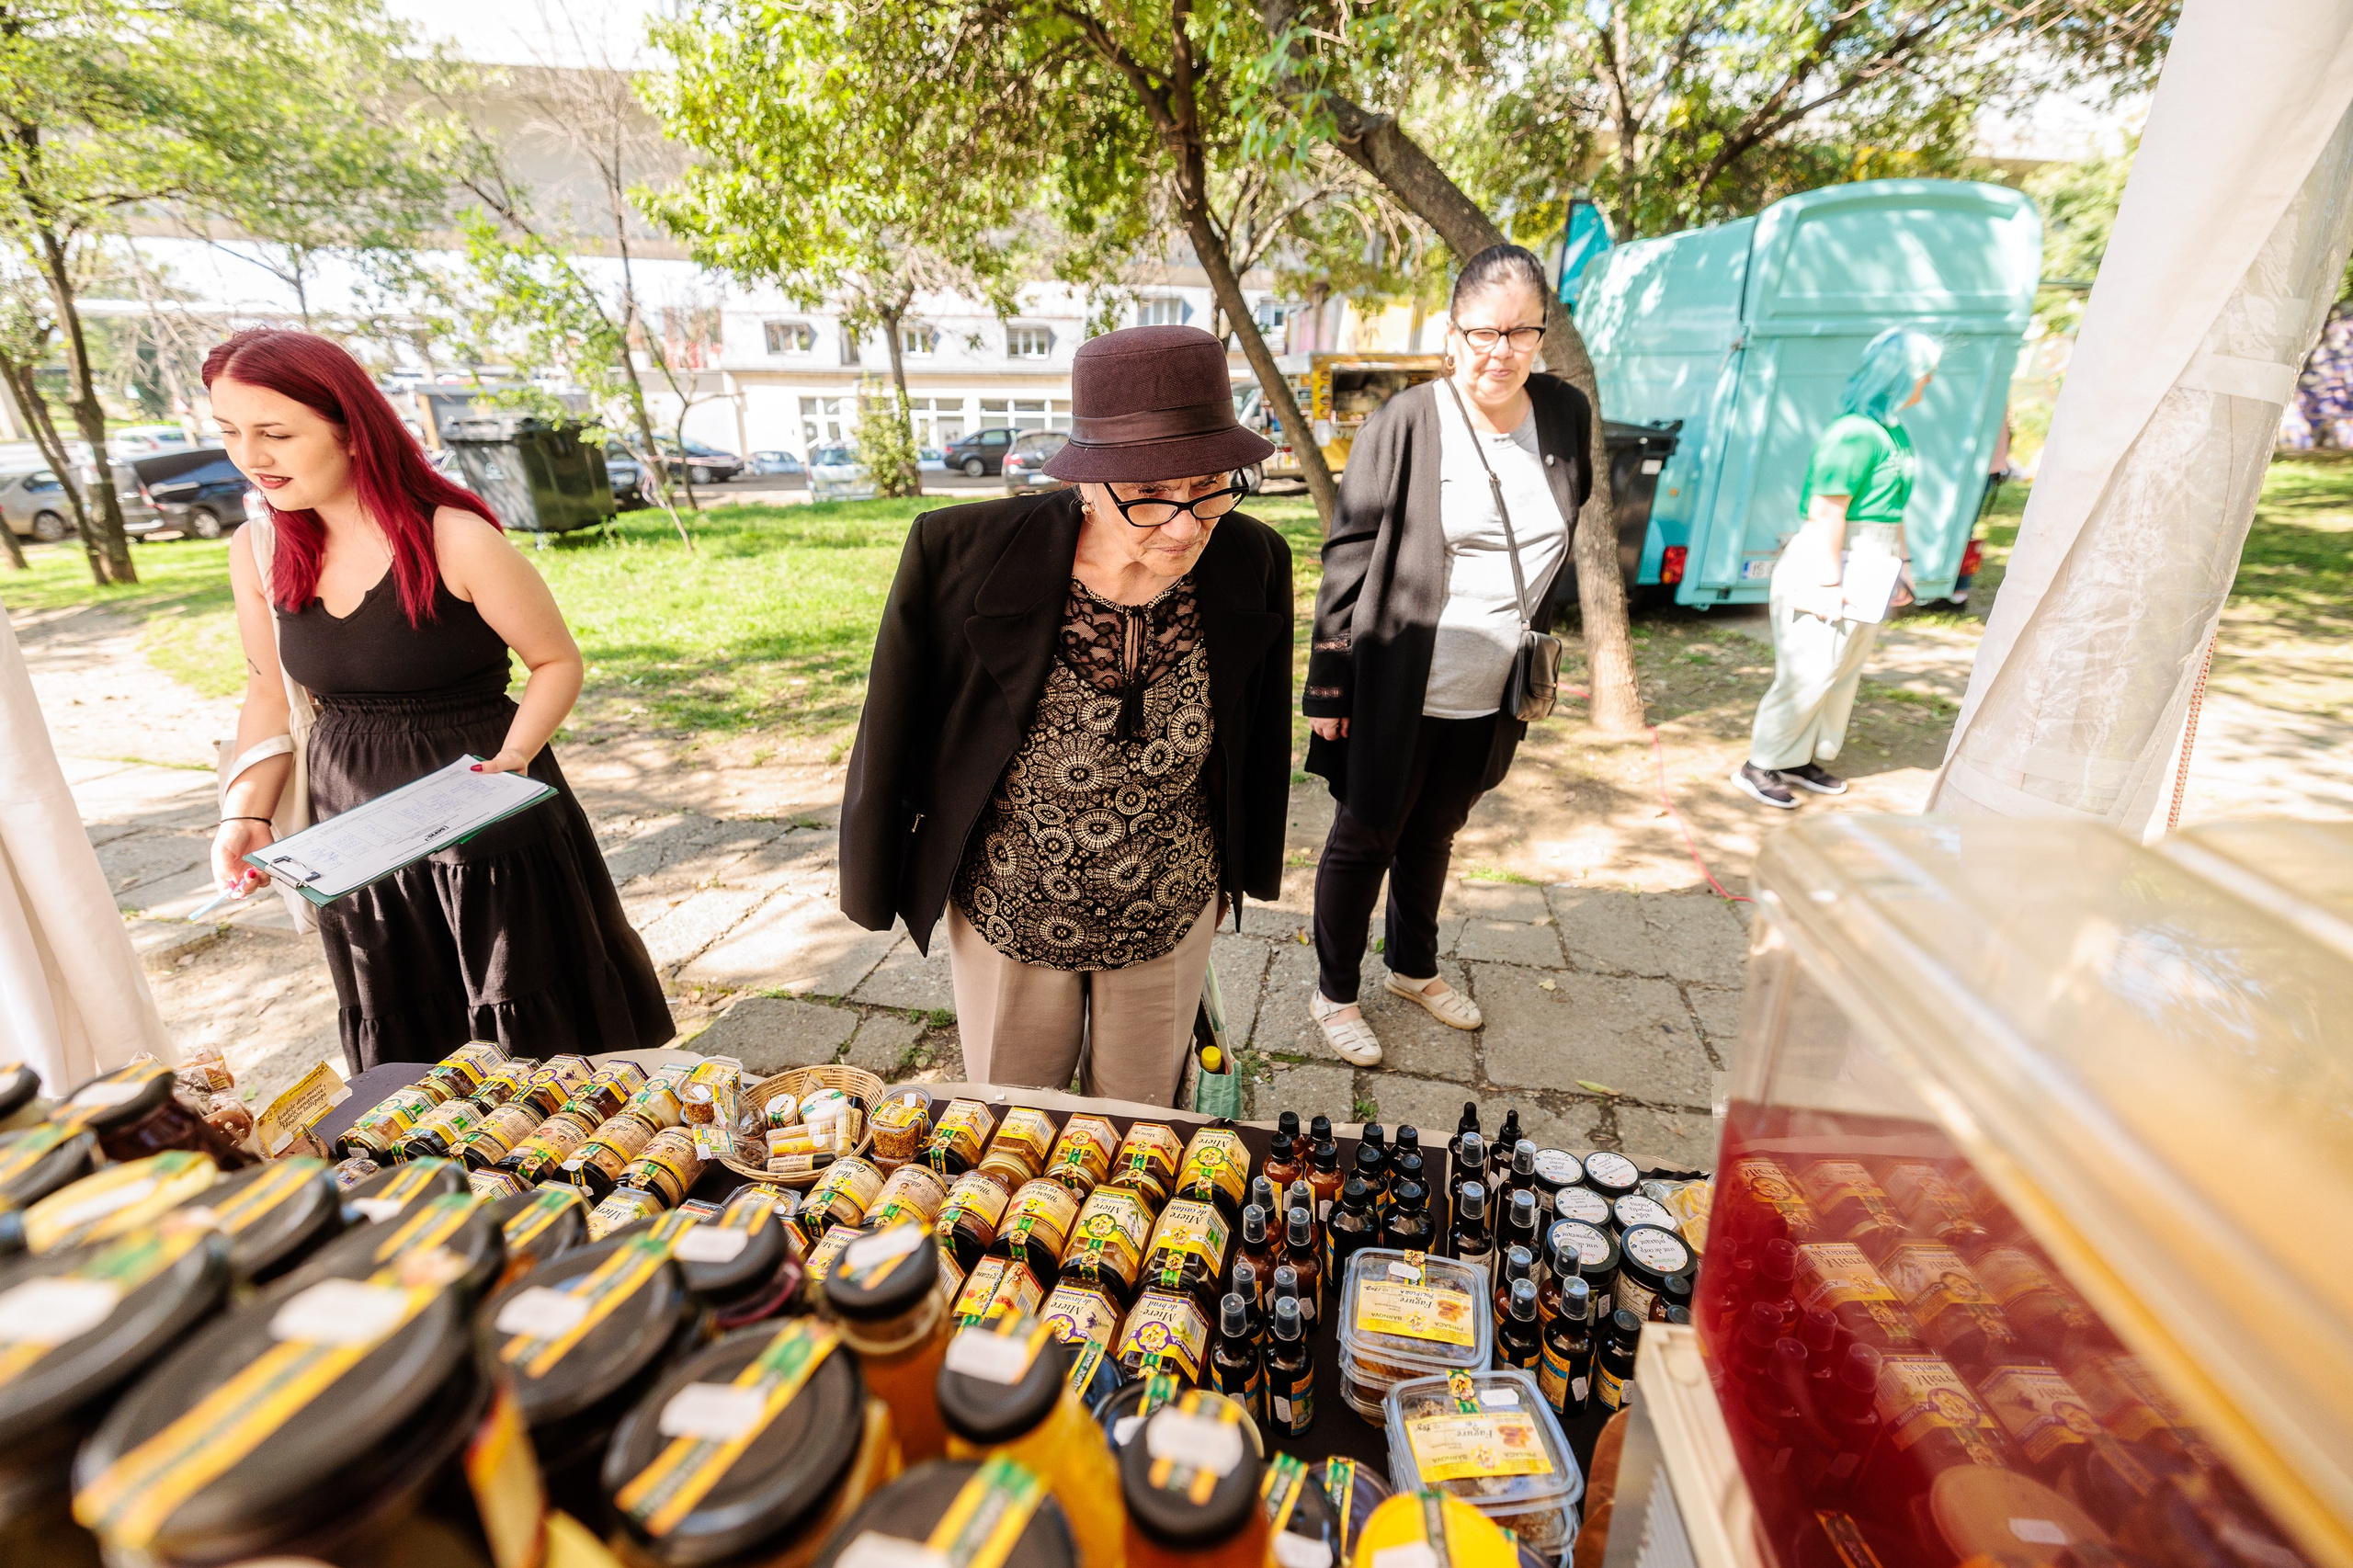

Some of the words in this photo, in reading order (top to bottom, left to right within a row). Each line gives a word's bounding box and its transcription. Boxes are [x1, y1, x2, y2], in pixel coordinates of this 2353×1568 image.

[277, 1103, 296, 1123] Acadele
[296, 1095, 306, 1107] din
[306, 1083, 324, 1096] miere
[282, 1110, 303, 1131] Healthy
[303, 1092, 327, 1114] lollipops
[278, 1108, 297, 1128] Acadele
[1197, 1138, 1229, 1149] Miere
[1036, 1190, 1058, 1203] Miere
[1093, 1203, 1121, 1214] Miere
[1170, 1205, 1199, 1215] castan
[1198, 1209, 1207, 1217] de
[1169, 1211, 1204, 1225] Miere
[1639, 1246, 1654, 1255] corp
[1400, 1290, 1434, 1299] POLIFLORA
[1081, 1298, 1092, 1306] de
[1148, 1300, 1167, 1310] brad
[1399, 1296, 1432, 1309] Fagure
[1051, 1301, 1084, 1316] Miere
[1142, 1309, 1176, 1323] Miere
[1434, 1322, 1464, 1332] PRISACA
[1171, 1336, 1195, 1361] PRISACA
[1456, 1427, 1493, 1439] Fagure
